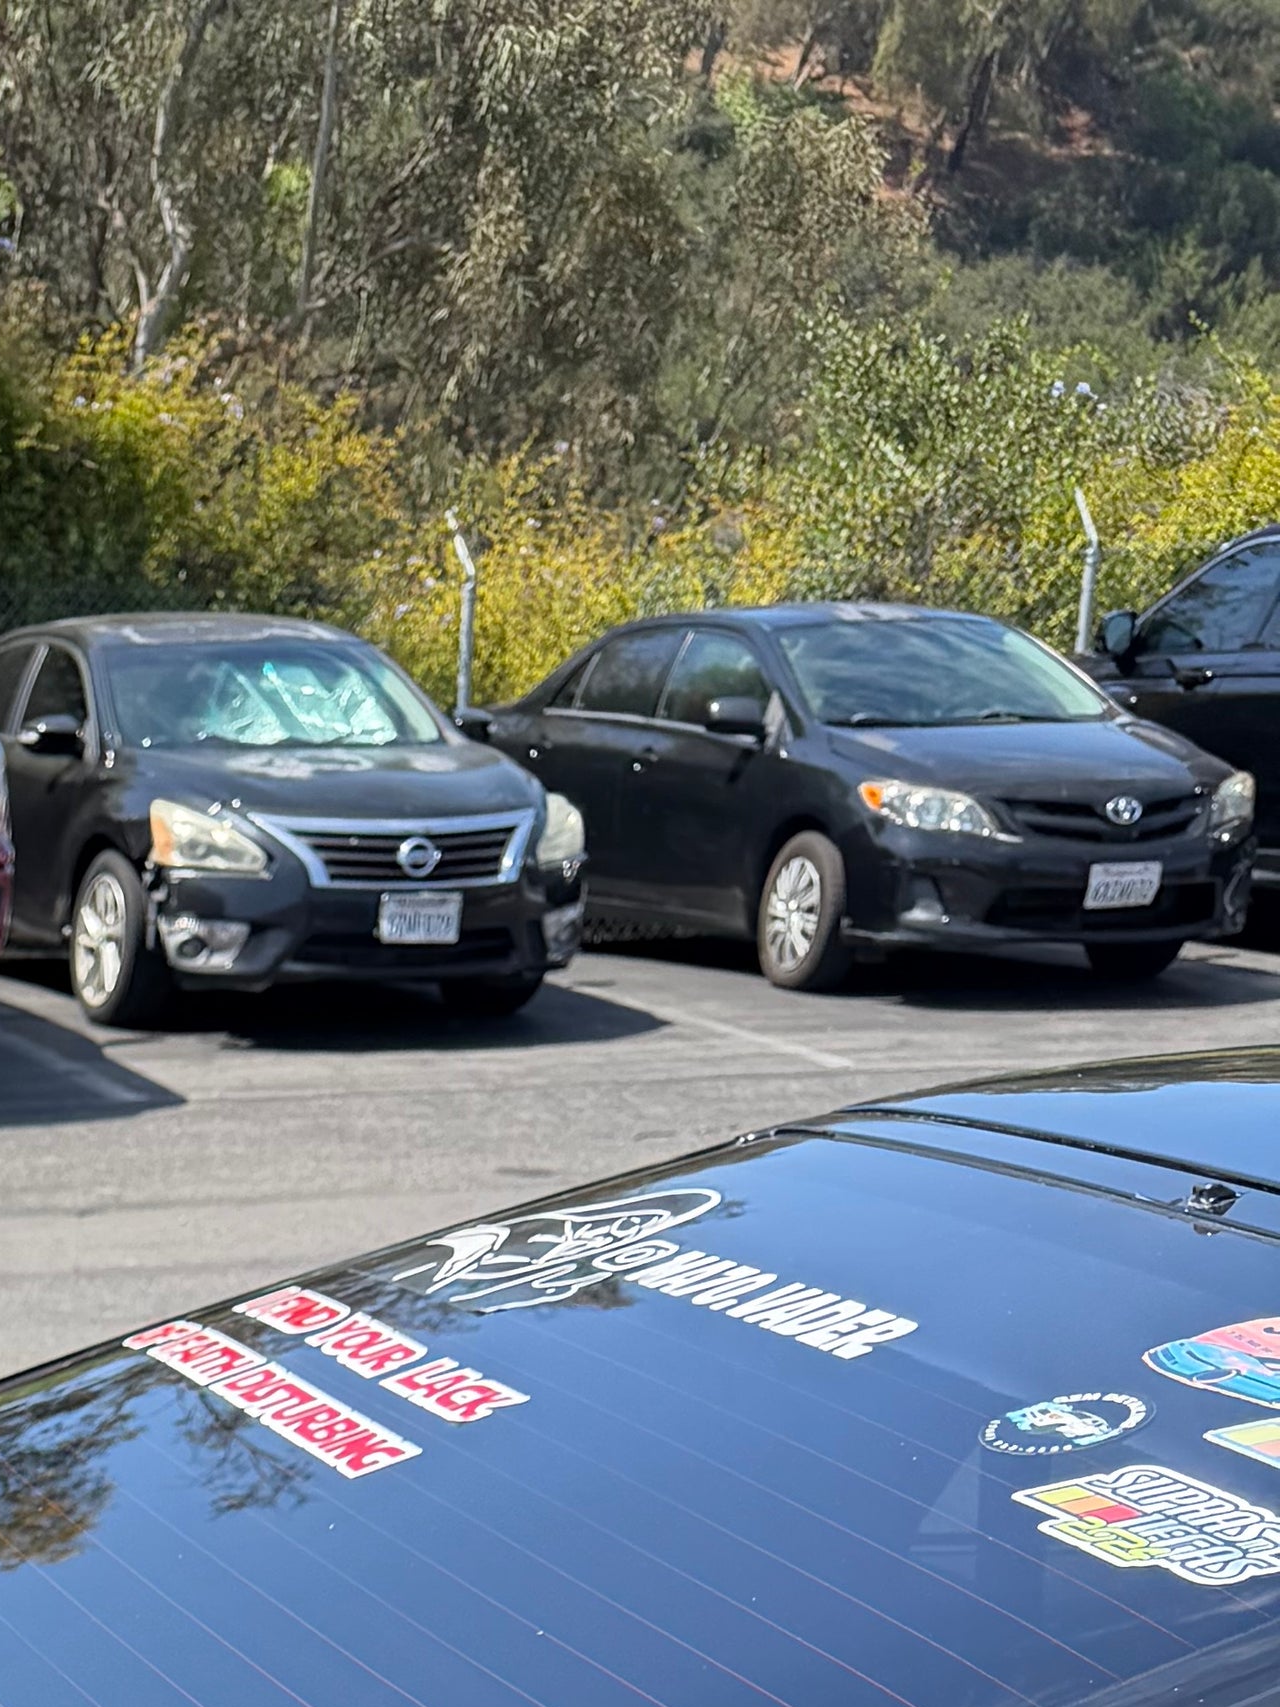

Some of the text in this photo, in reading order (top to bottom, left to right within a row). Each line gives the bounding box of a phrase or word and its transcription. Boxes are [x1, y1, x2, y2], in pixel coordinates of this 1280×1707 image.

[146, 1327, 268, 1386] FAITH
[208, 1361, 422, 1479] DISTURBING
[305, 1312, 428, 1379] YOUR
[379, 1357, 530, 1423] LACK
